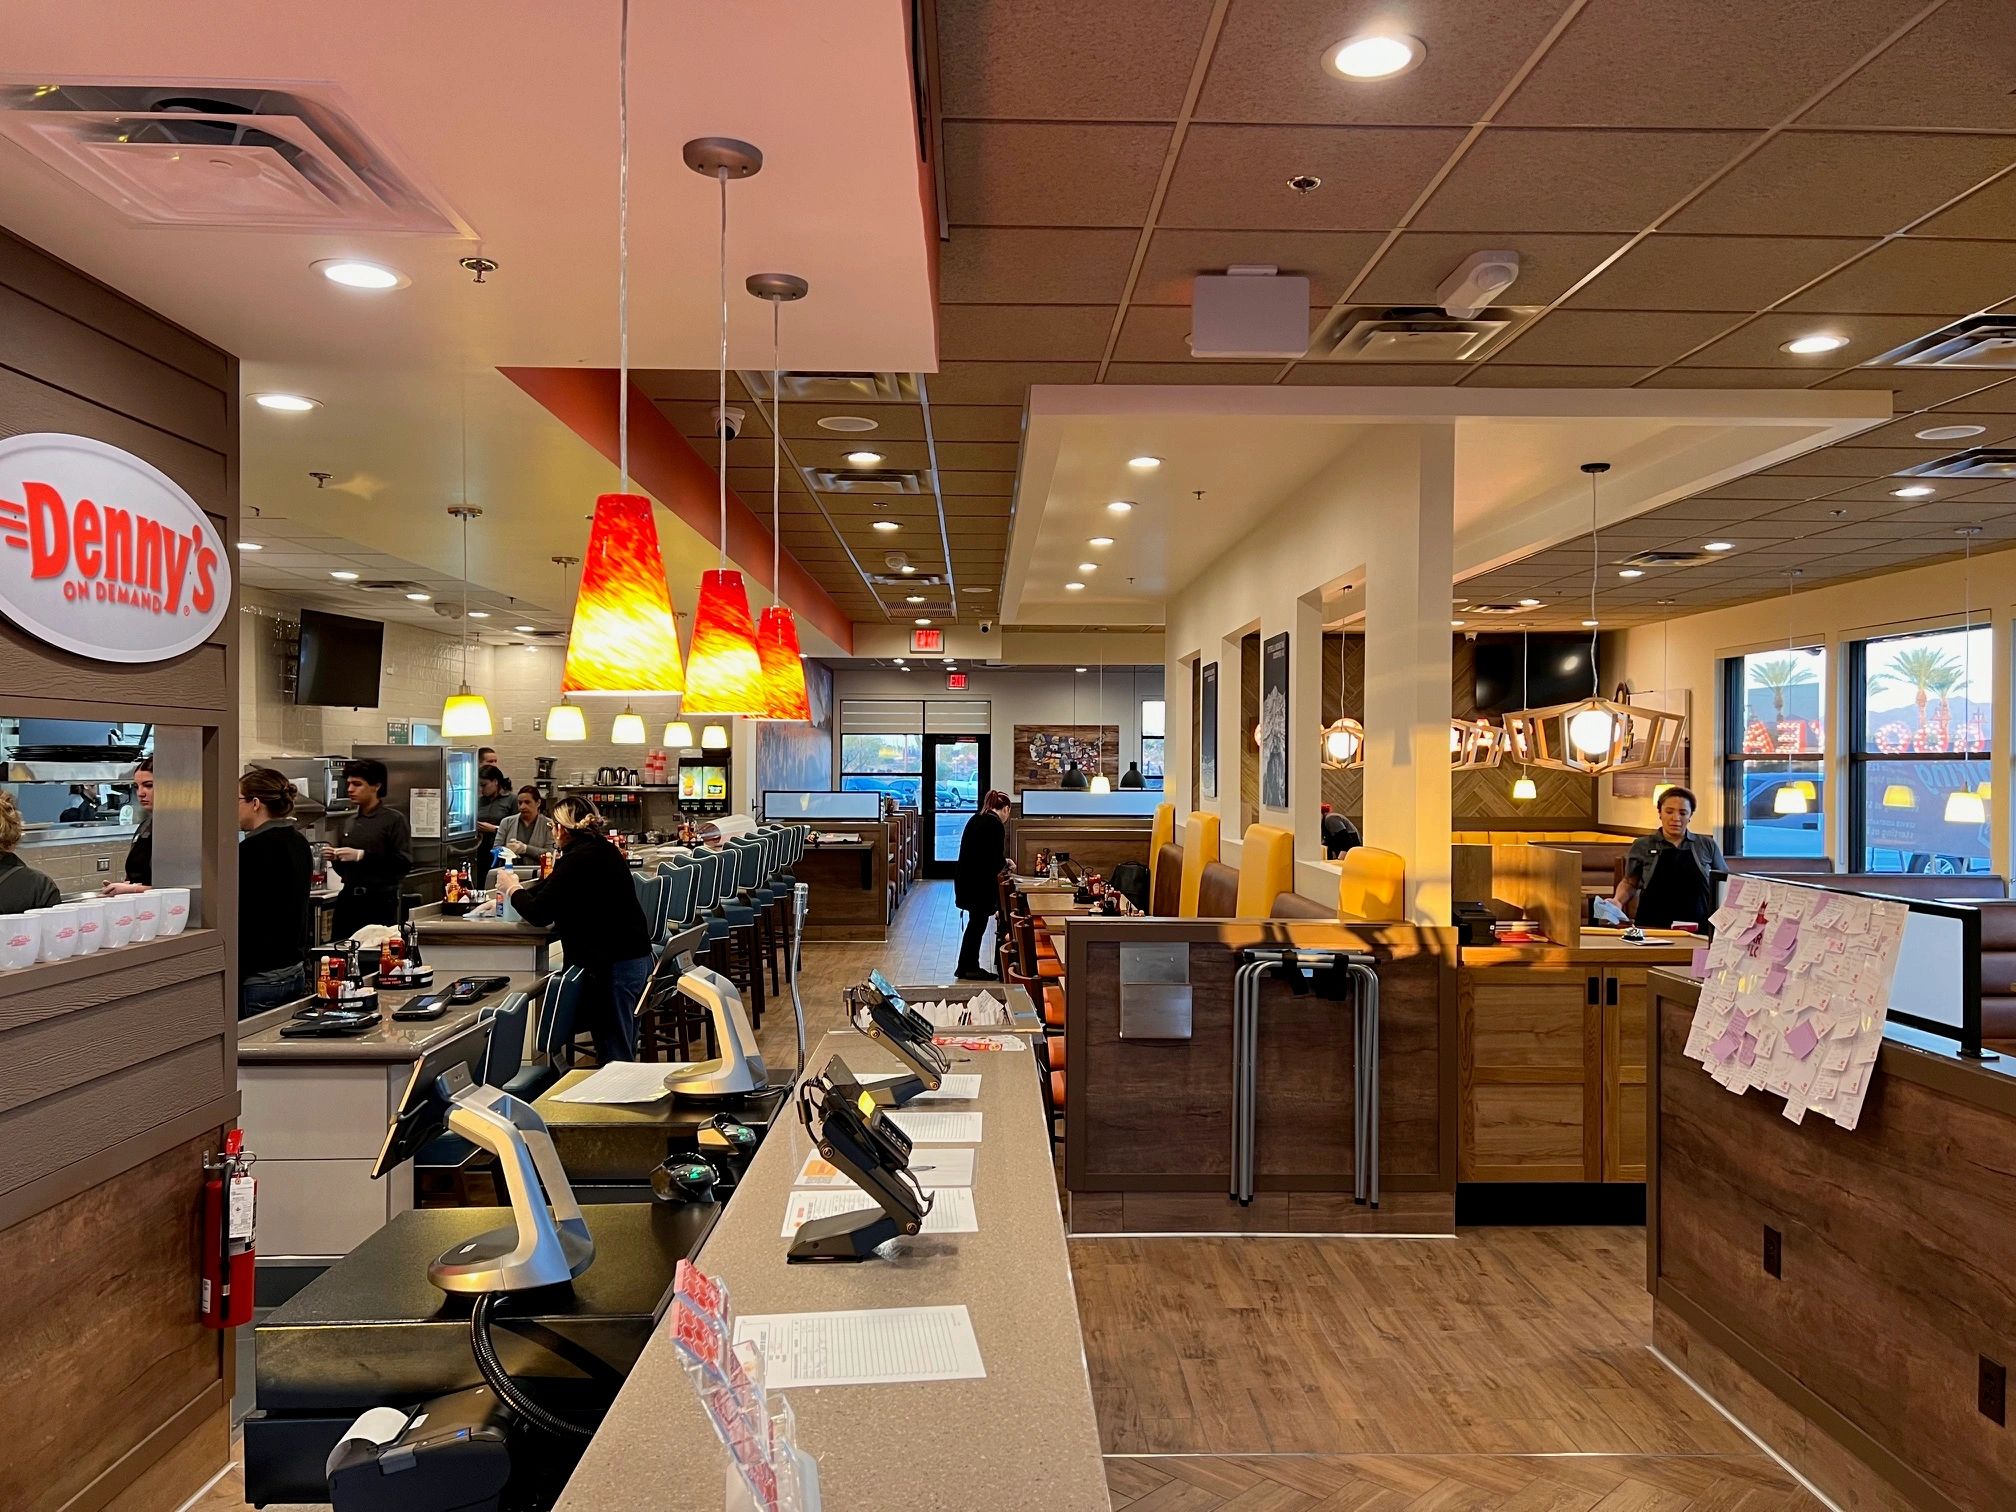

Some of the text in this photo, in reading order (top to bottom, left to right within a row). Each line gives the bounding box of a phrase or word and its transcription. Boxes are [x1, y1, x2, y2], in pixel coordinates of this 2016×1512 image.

[22, 482, 218, 614] Denny's
[63, 581, 162, 614] ON DEMAND
[915, 630, 940, 648] EXIT
[950, 674, 966, 687] EXIT
